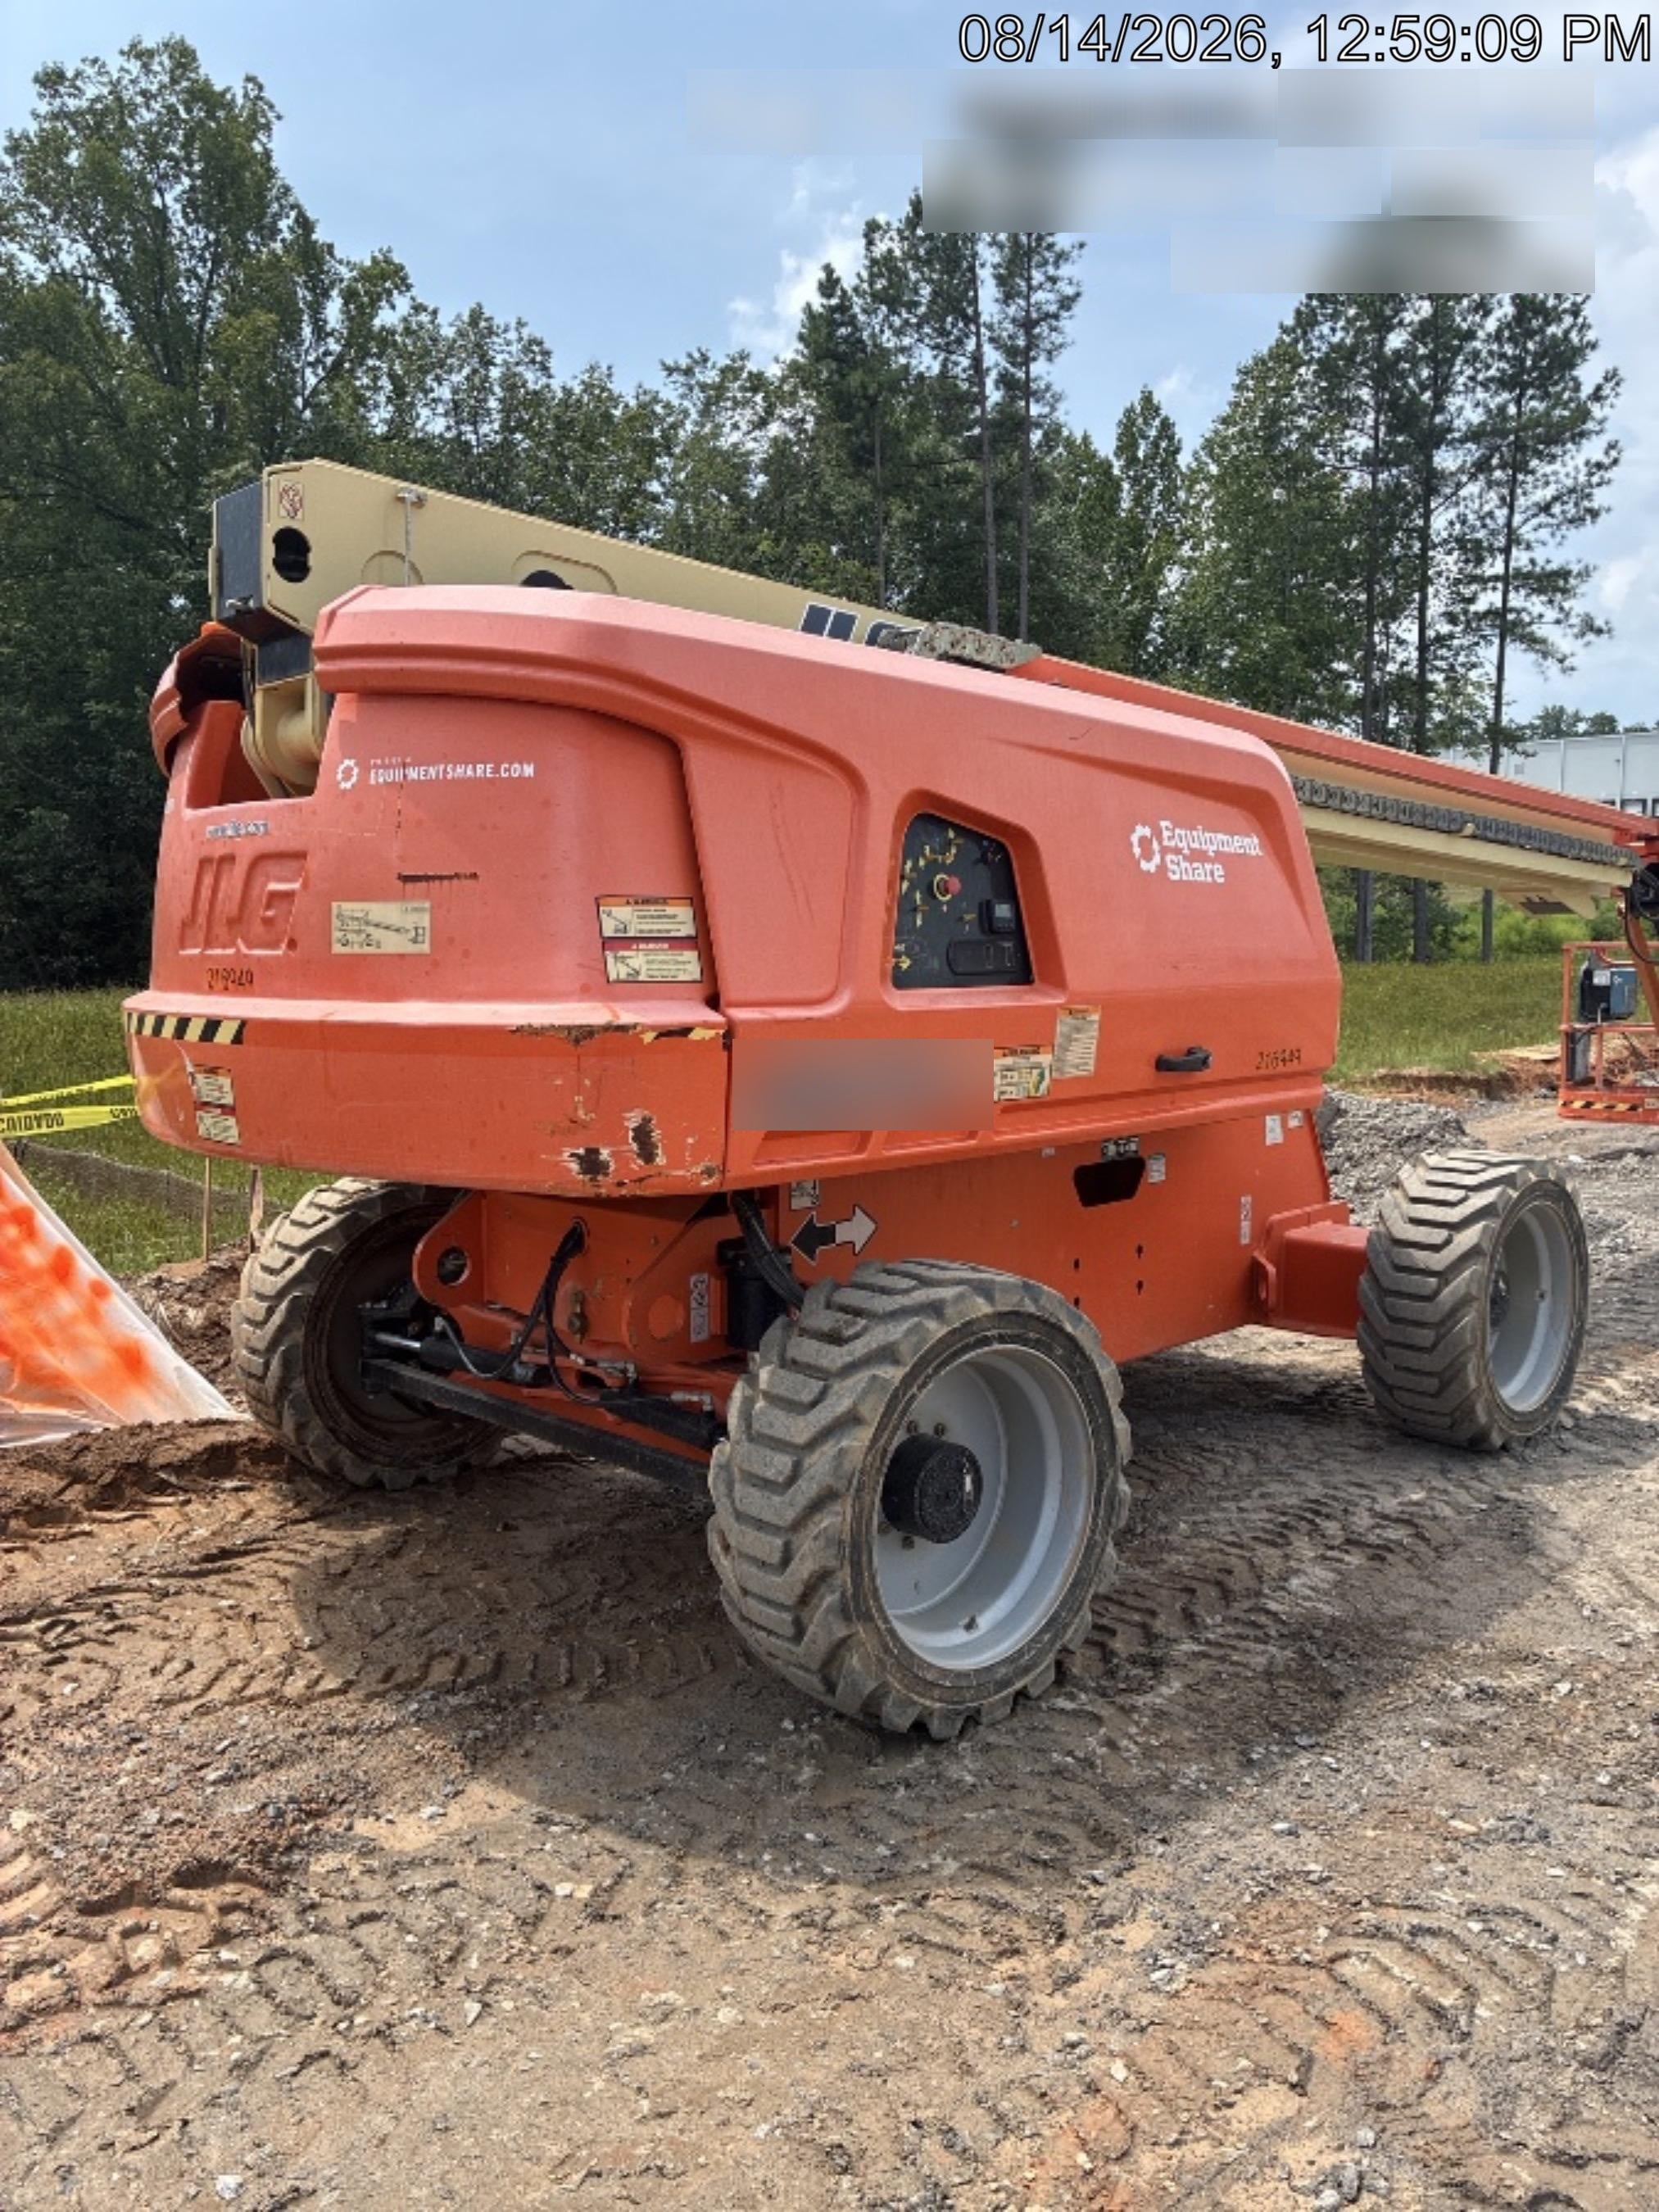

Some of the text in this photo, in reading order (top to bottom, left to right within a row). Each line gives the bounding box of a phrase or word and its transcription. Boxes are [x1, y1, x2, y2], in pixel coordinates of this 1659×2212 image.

[369, 762, 535, 785] EQUIPMENTSHARE.COM
[1159, 820, 1262, 857] Equipment
[1165, 854, 1226, 883] Share
